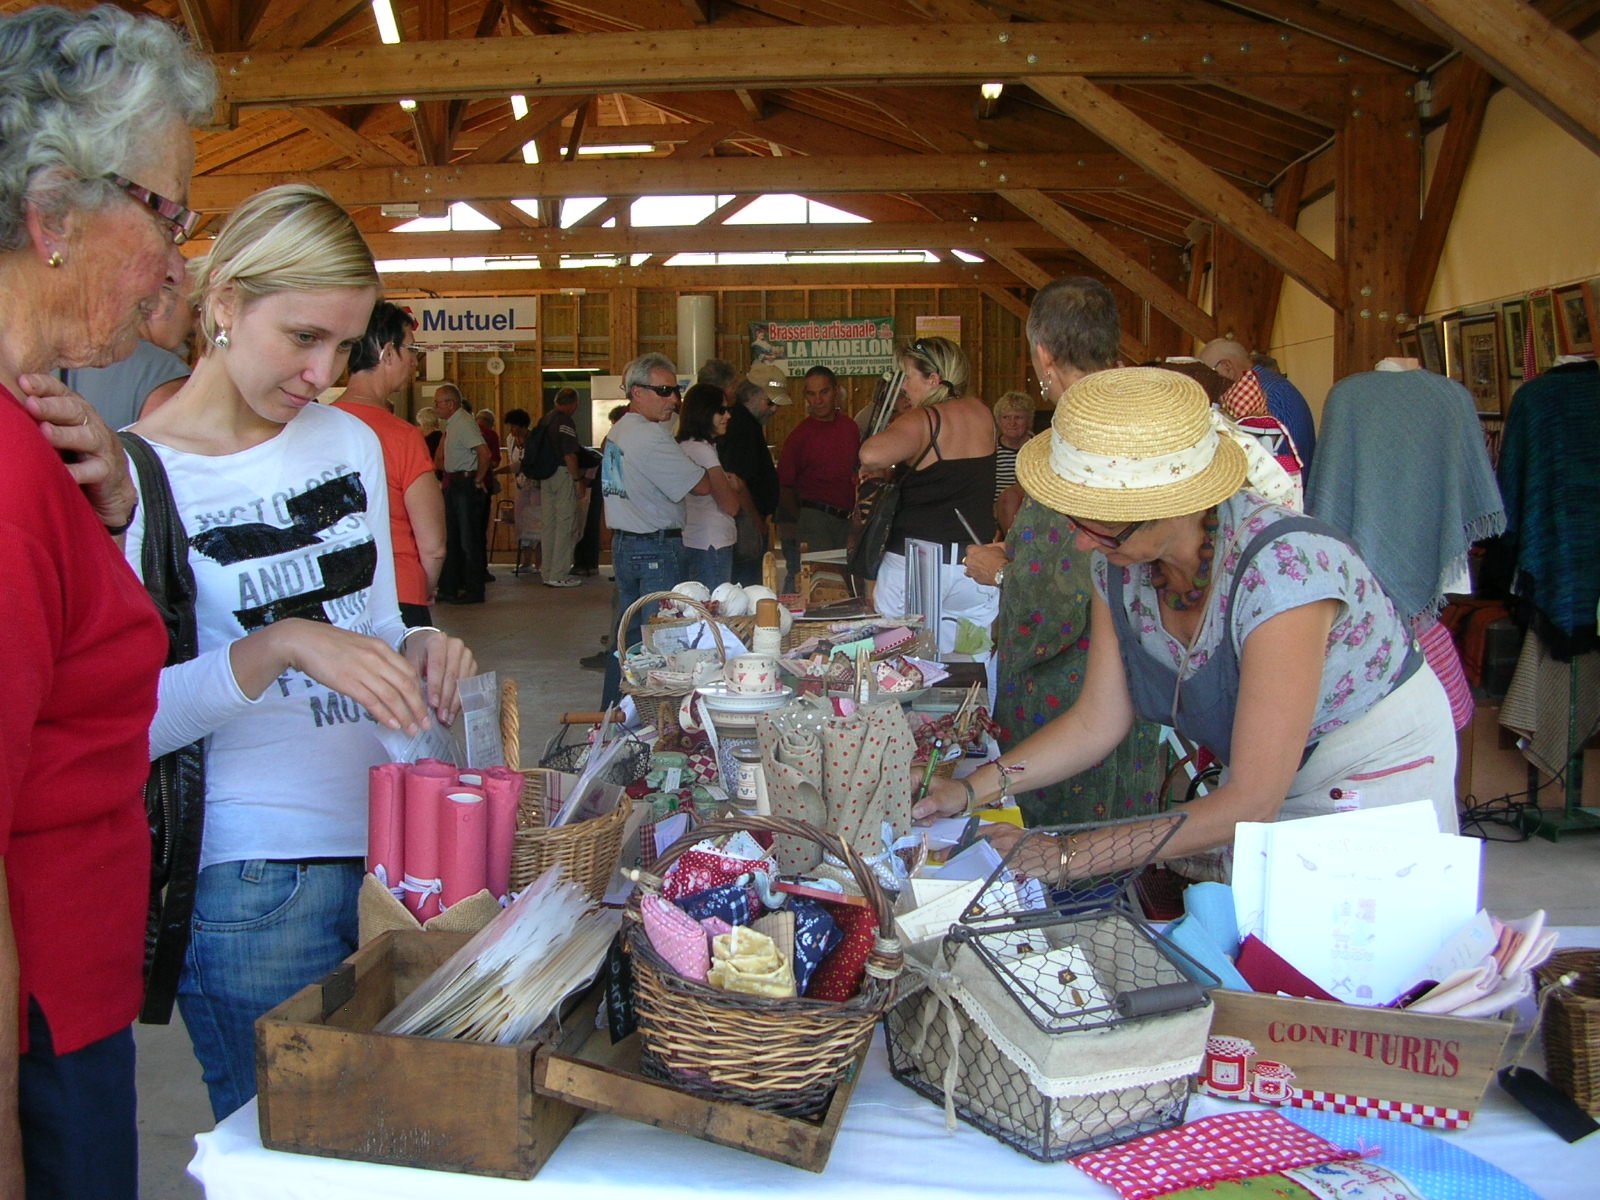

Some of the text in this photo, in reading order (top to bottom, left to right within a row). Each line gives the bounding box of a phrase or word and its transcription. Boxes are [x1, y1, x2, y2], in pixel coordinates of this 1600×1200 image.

[422, 308, 514, 332] Mutuel
[769, 322, 820, 341] Brasserie
[822, 319, 876, 339] artisanale
[787, 339, 893, 358] LA MADELON
[238, 558, 305, 611] AND
[1267, 1020, 1461, 1079] CONFITURES
